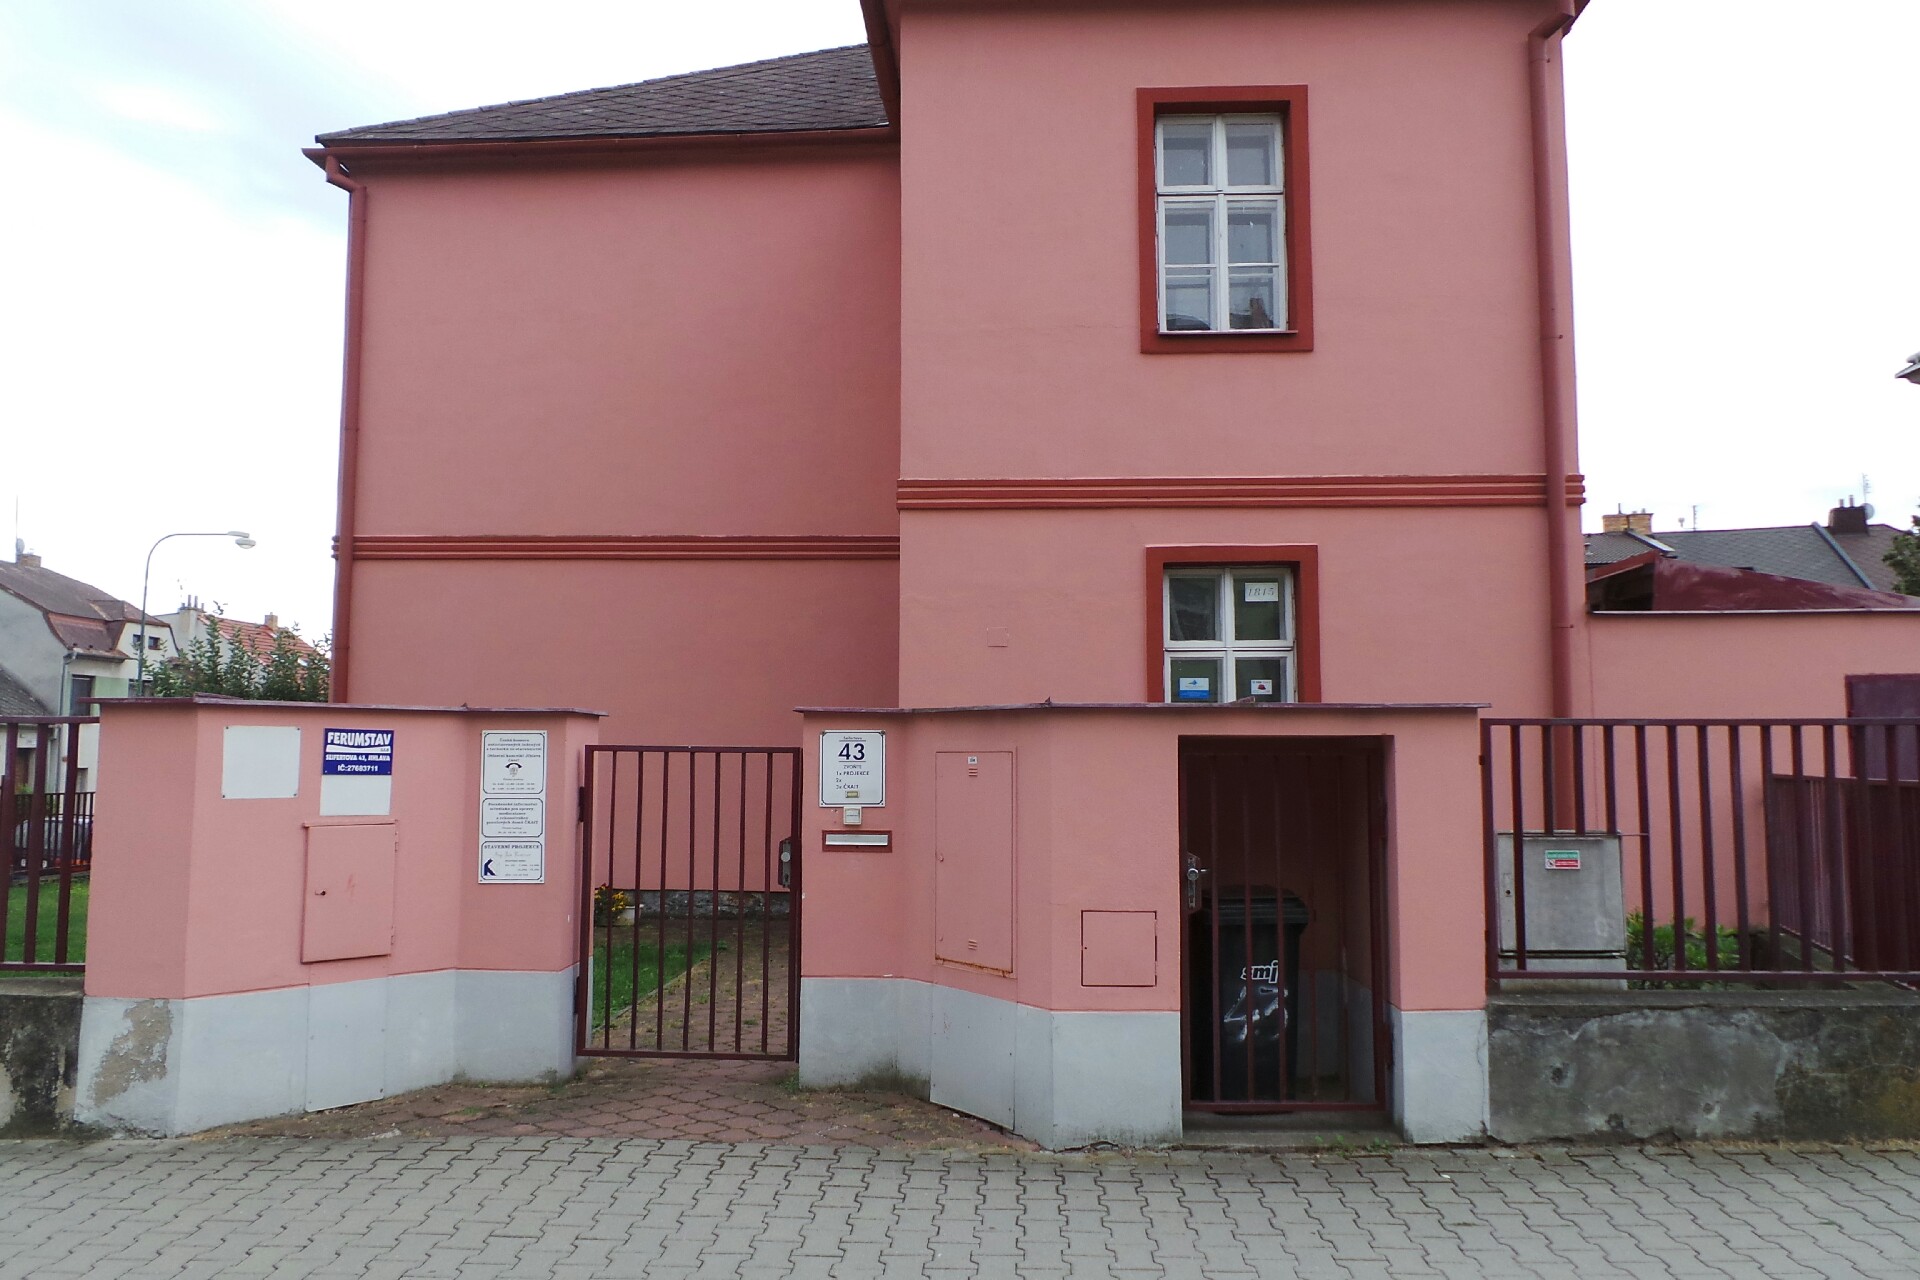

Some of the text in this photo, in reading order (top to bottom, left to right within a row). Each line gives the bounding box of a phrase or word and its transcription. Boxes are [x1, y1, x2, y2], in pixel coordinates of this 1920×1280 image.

[1248, 587, 1275, 596] 1815
[327, 732, 391, 746] FERUMSTAV
[838, 743, 866, 761] 43
